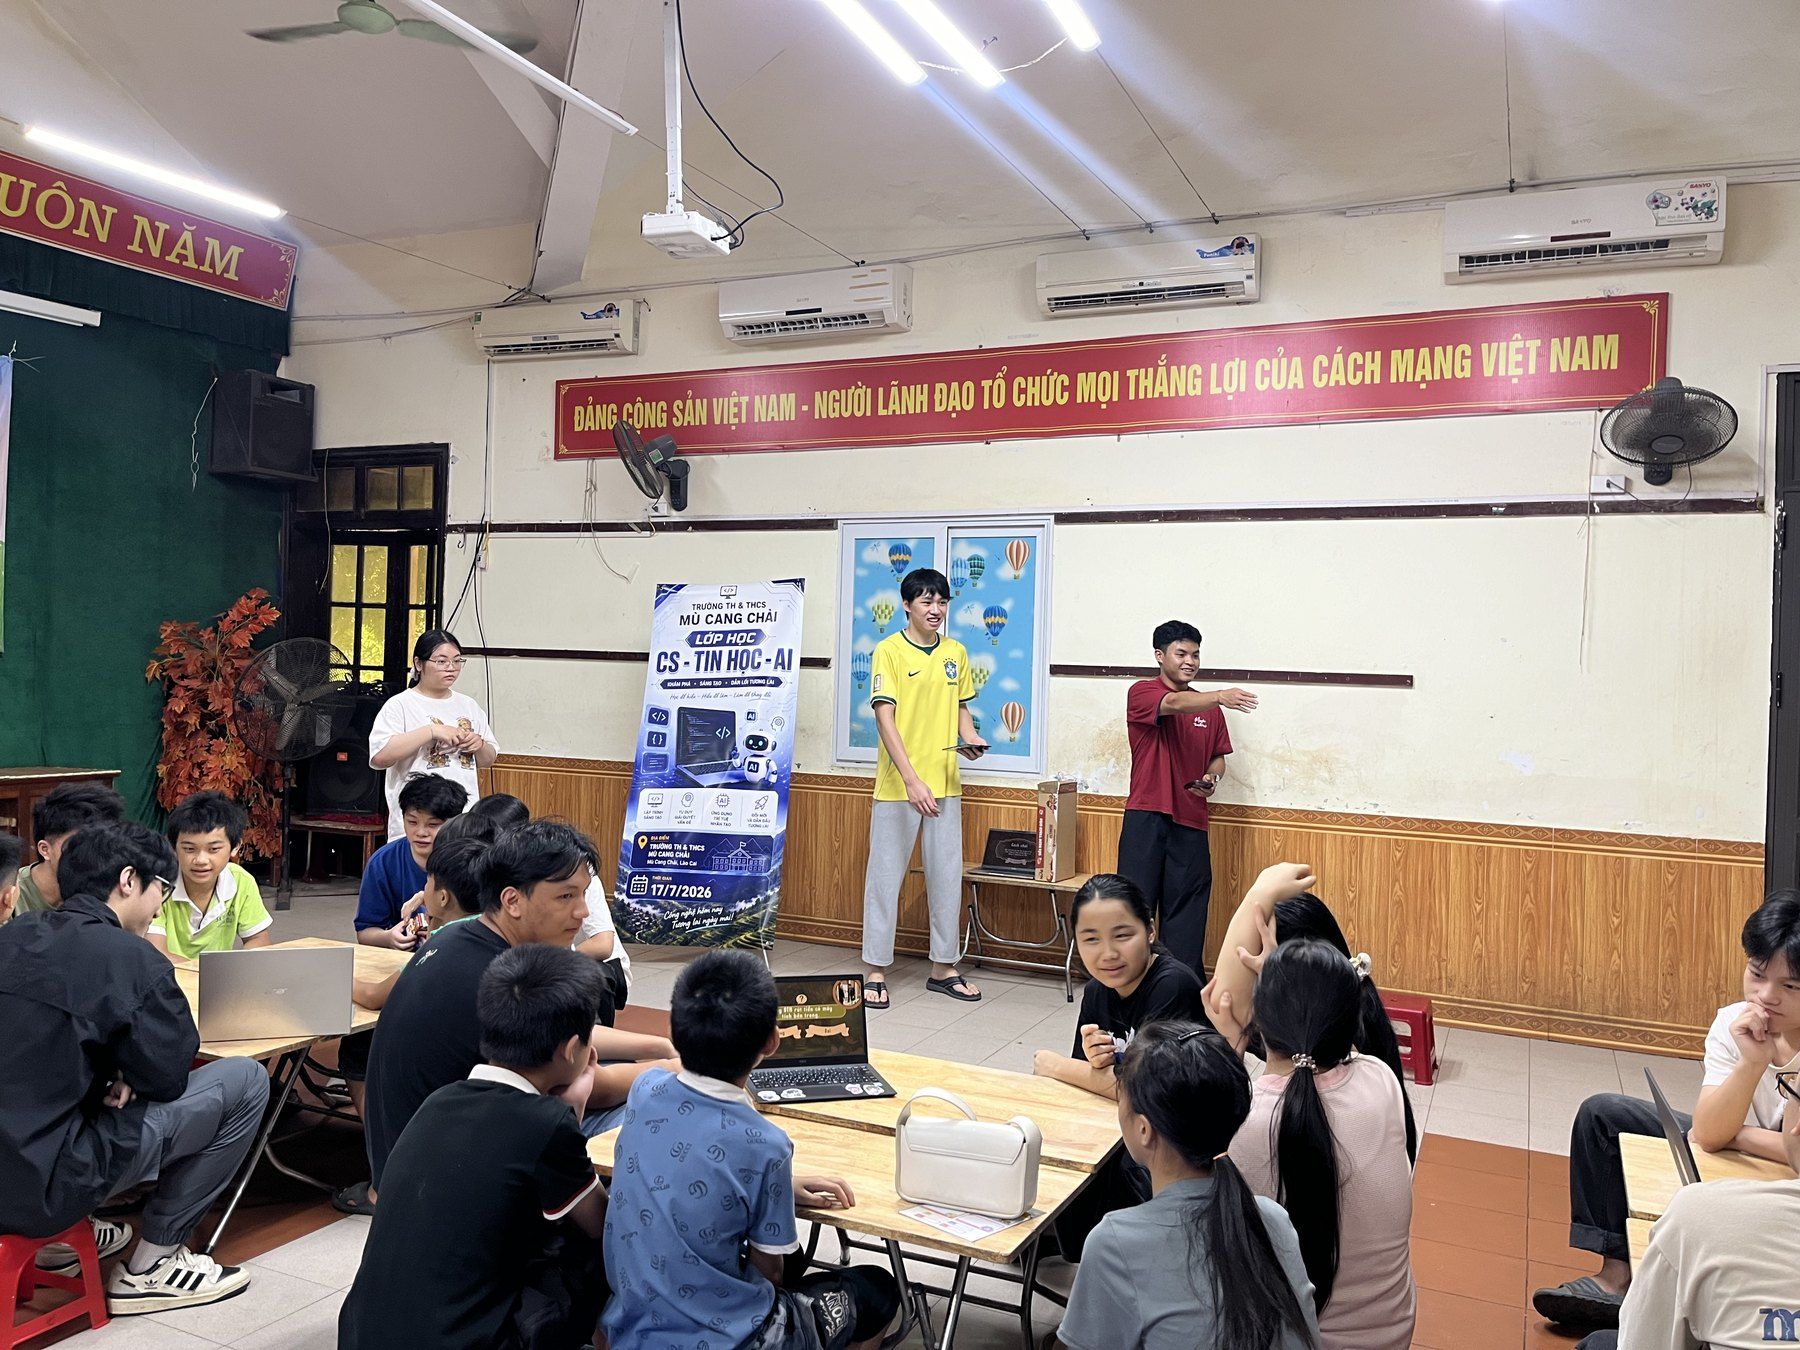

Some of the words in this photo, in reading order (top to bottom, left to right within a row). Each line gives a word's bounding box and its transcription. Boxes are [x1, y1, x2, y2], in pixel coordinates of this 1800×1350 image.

[127, 213, 244, 281] NĂM
[574, 396, 618, 432] ĐẢNG
[622, 397, 668, 434] CỘNG
[672, 390, 707, 427] SẢN
[712, 390, 749, 430] VIỆT
[754, 393, 796, 422] NAM
[814, 381, 872, 419] NGƯỜI
[878, 379, 928, 416] LÃNH
[933, 380, 974, 418] ĐẠO
[981, 365, 1007, 408] TỔ
[1013, 367, 1070, 406] CHỨC
[1076, 371, 1119, 408] MỌI
[1126, 354, 1202, 400] THẮNG
[1210, 358, 1246, 400] LỢI
[1254, 345, 1303, 391] CỦA
[1312, 345, 1382, 388] CÁCH
[1389, 344, 1473, 390] MẠNG
[1480, 333, 1540, 385] VIỆT
[1548, 334, 1619, 373] NAM
[692, 602, 723, 610] TRƯỜNG
[680, 612, 700, 626] MÙ
[705, 612, 742, 624] CANG
[695, 631, 724, 645] LỚP
[726, 632, 756, 646] HỌC
[656, 651, 680, 672] CS
[694, 650, 722, 672] TIN
[726, 648, 762, 674] HỌC
[774, 648, 793, 670] AI
[650, 884, 712, 898] 17/7/2026
